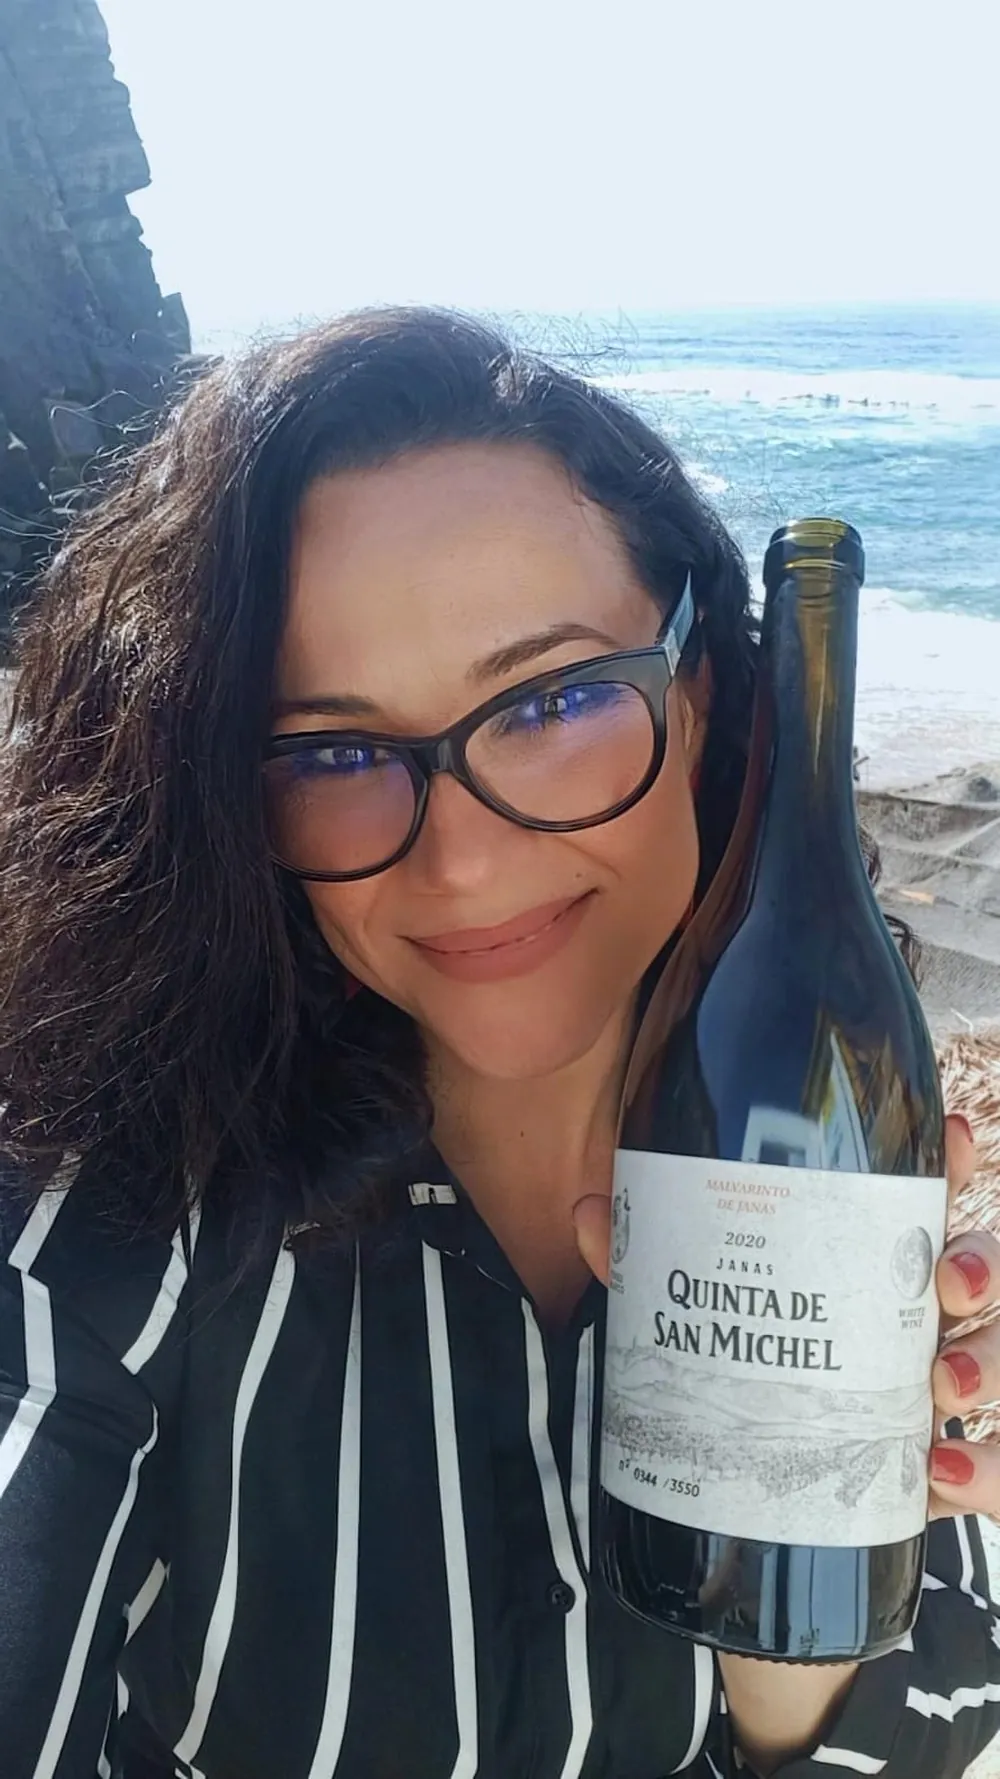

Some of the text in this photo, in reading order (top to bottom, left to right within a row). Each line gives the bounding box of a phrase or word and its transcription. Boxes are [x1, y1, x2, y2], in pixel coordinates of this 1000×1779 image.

[705, 1179, 791, 1198] MALVARINTO
[716, 1198, 777, 1215] DE JANAS
[724, 1231, 767, 1249] 2020
[716, 1257, 774, 1276] JANAS
[790, 1291, 829, 1323] DE
[654, 1311, 842, 1371] SAN MICHEL
[633, 1467, 658, 1487] 0344
